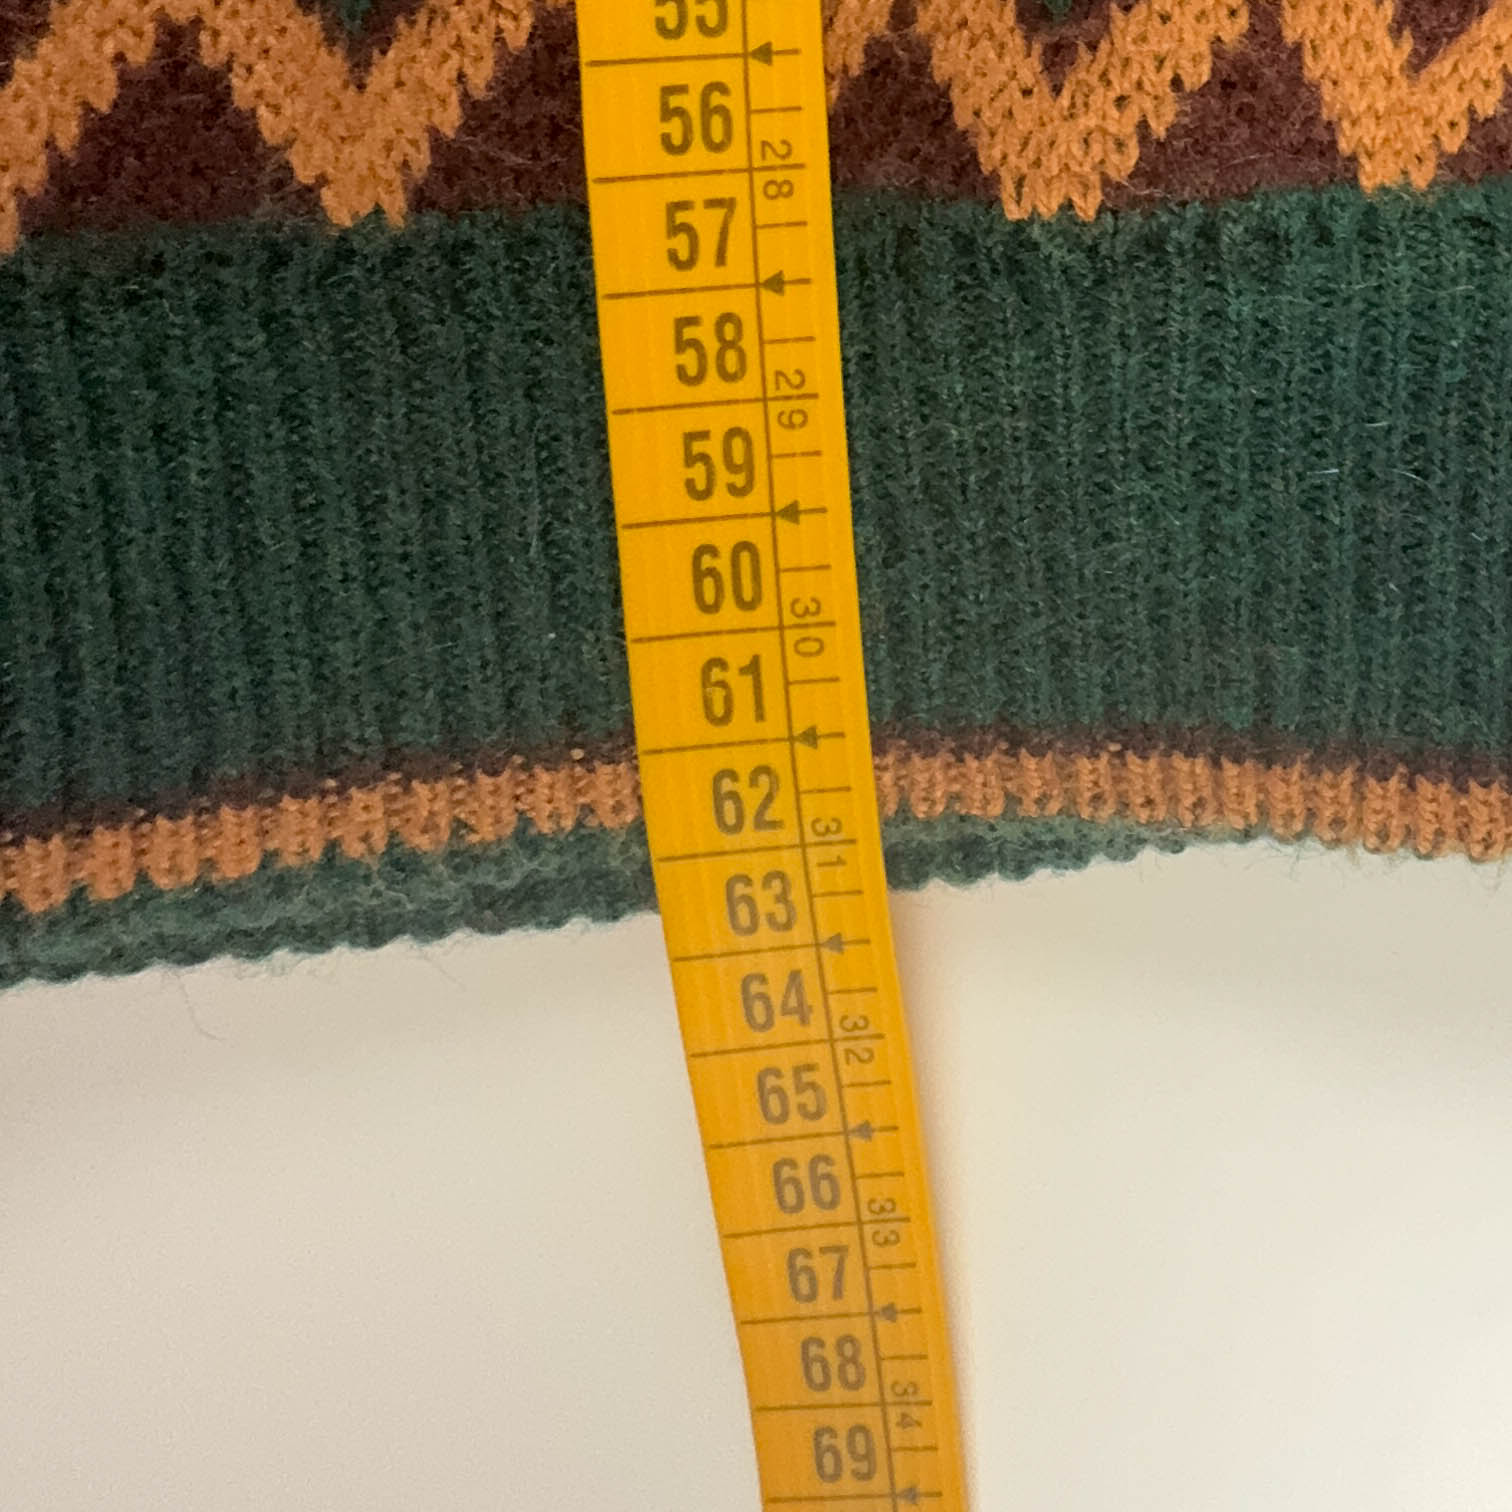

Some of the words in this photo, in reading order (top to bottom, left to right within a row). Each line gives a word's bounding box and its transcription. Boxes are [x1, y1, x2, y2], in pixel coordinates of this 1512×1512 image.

[659, 81, 733, 156] 56
[665, 197, 737, 272] 57
[673, 312, 747, 387] 58
[682, 426, 756, 502] 59
[691, 540, 763, 615] 60
[701, 654, 768, 728] 61
[711, 764, 784, 836] 62
[724, 870, 797, 937] 63
[740, 970, 812, 1033] 64
[757, 1063, 828, 1125] 65
[772, 1154, 841, 1215] 66
[787, 1245, 849, 1304] 67
[801, 1334, 866, 1392] 68
[813, 1424, 877, 1484] 69
